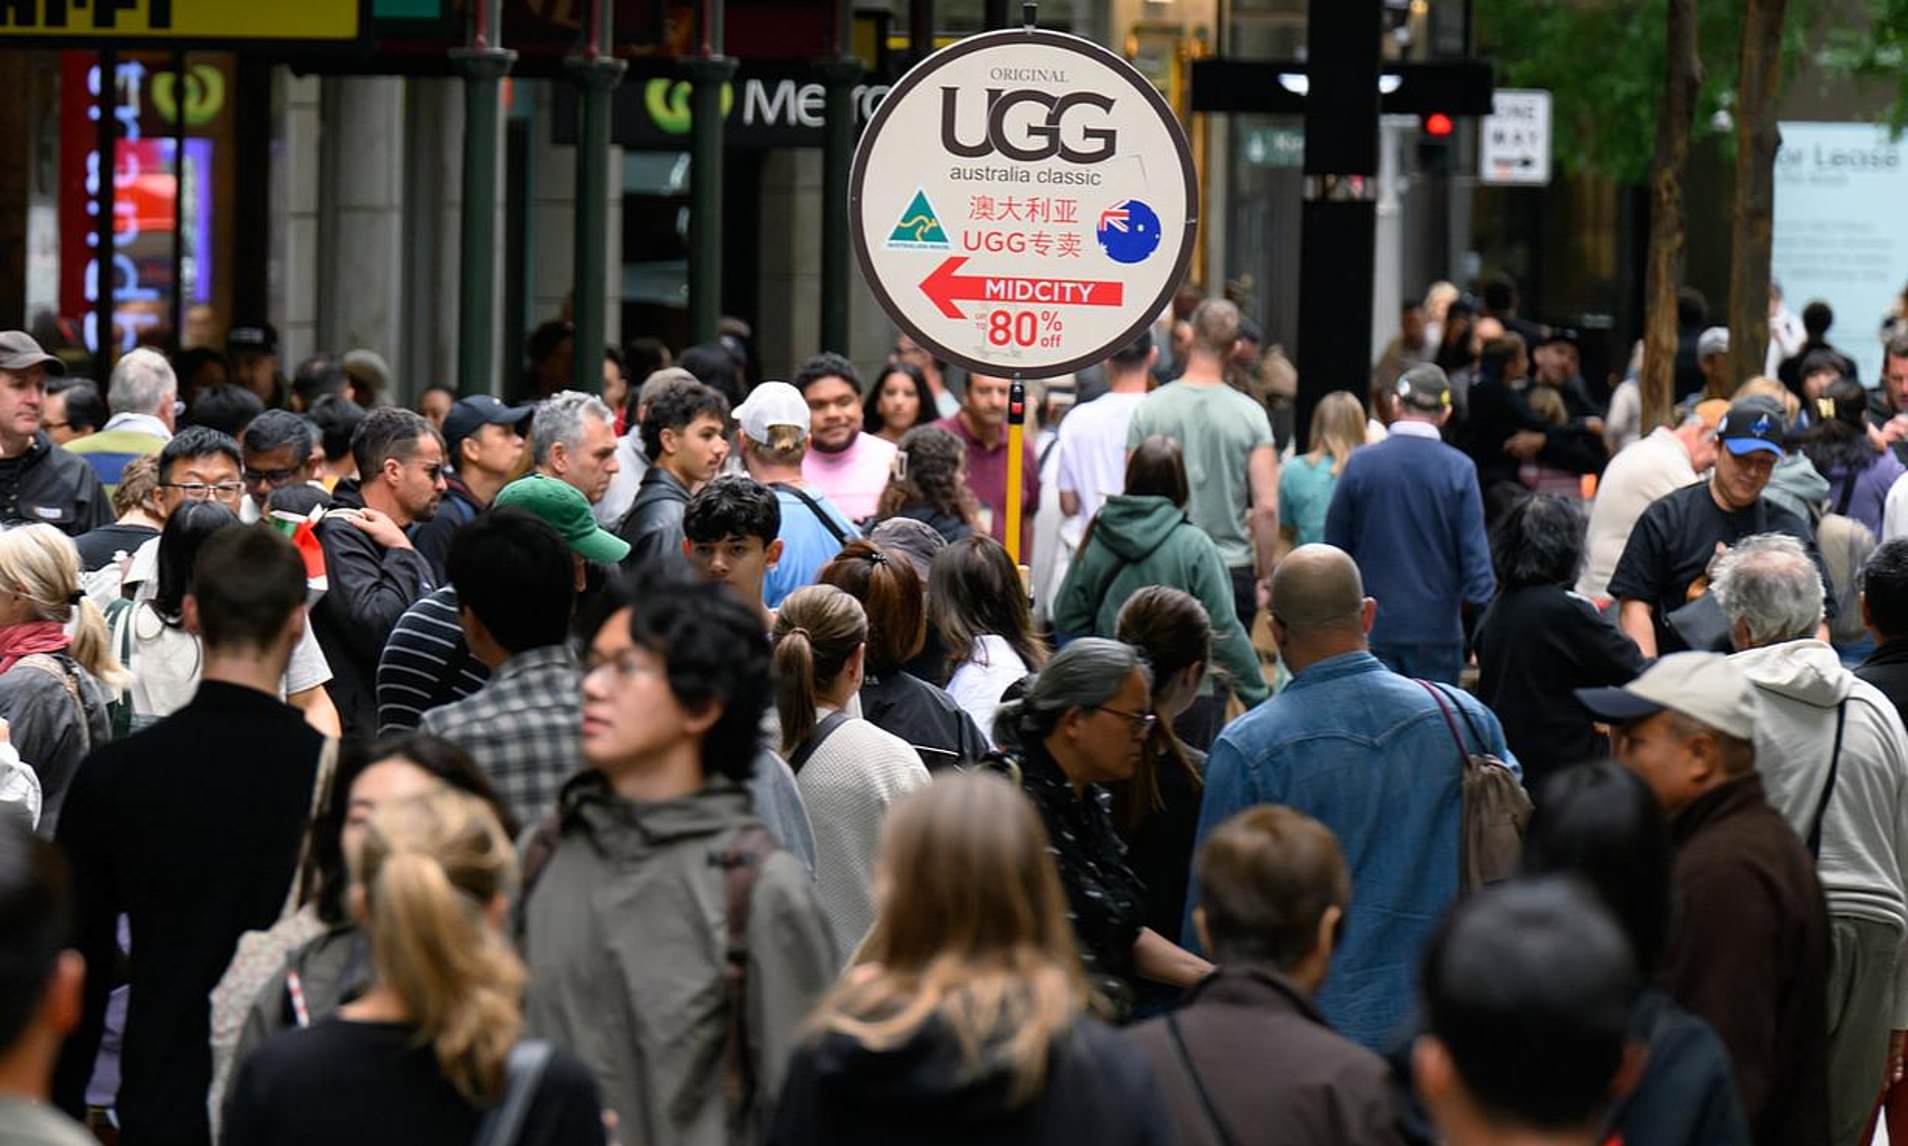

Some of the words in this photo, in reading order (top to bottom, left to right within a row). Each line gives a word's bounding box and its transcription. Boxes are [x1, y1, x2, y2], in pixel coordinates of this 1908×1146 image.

[990, 67, 1069, 83] ORIGINAL
[743, 79, 890, 126] Mero
[939, 86, 1117, 164] UGG
[1814, 143, 1899, 168] Lease
[950, 166, 1030, 183] australia
[1037, 168, 1102, 186] classic
[969, 195, 1080, 224] 澳大利亚
[963, 230, 1082, 258] UGG专卖
[985, 278, 1096, 303] MIDCITY
[1040, 334, 1063, 348] off
